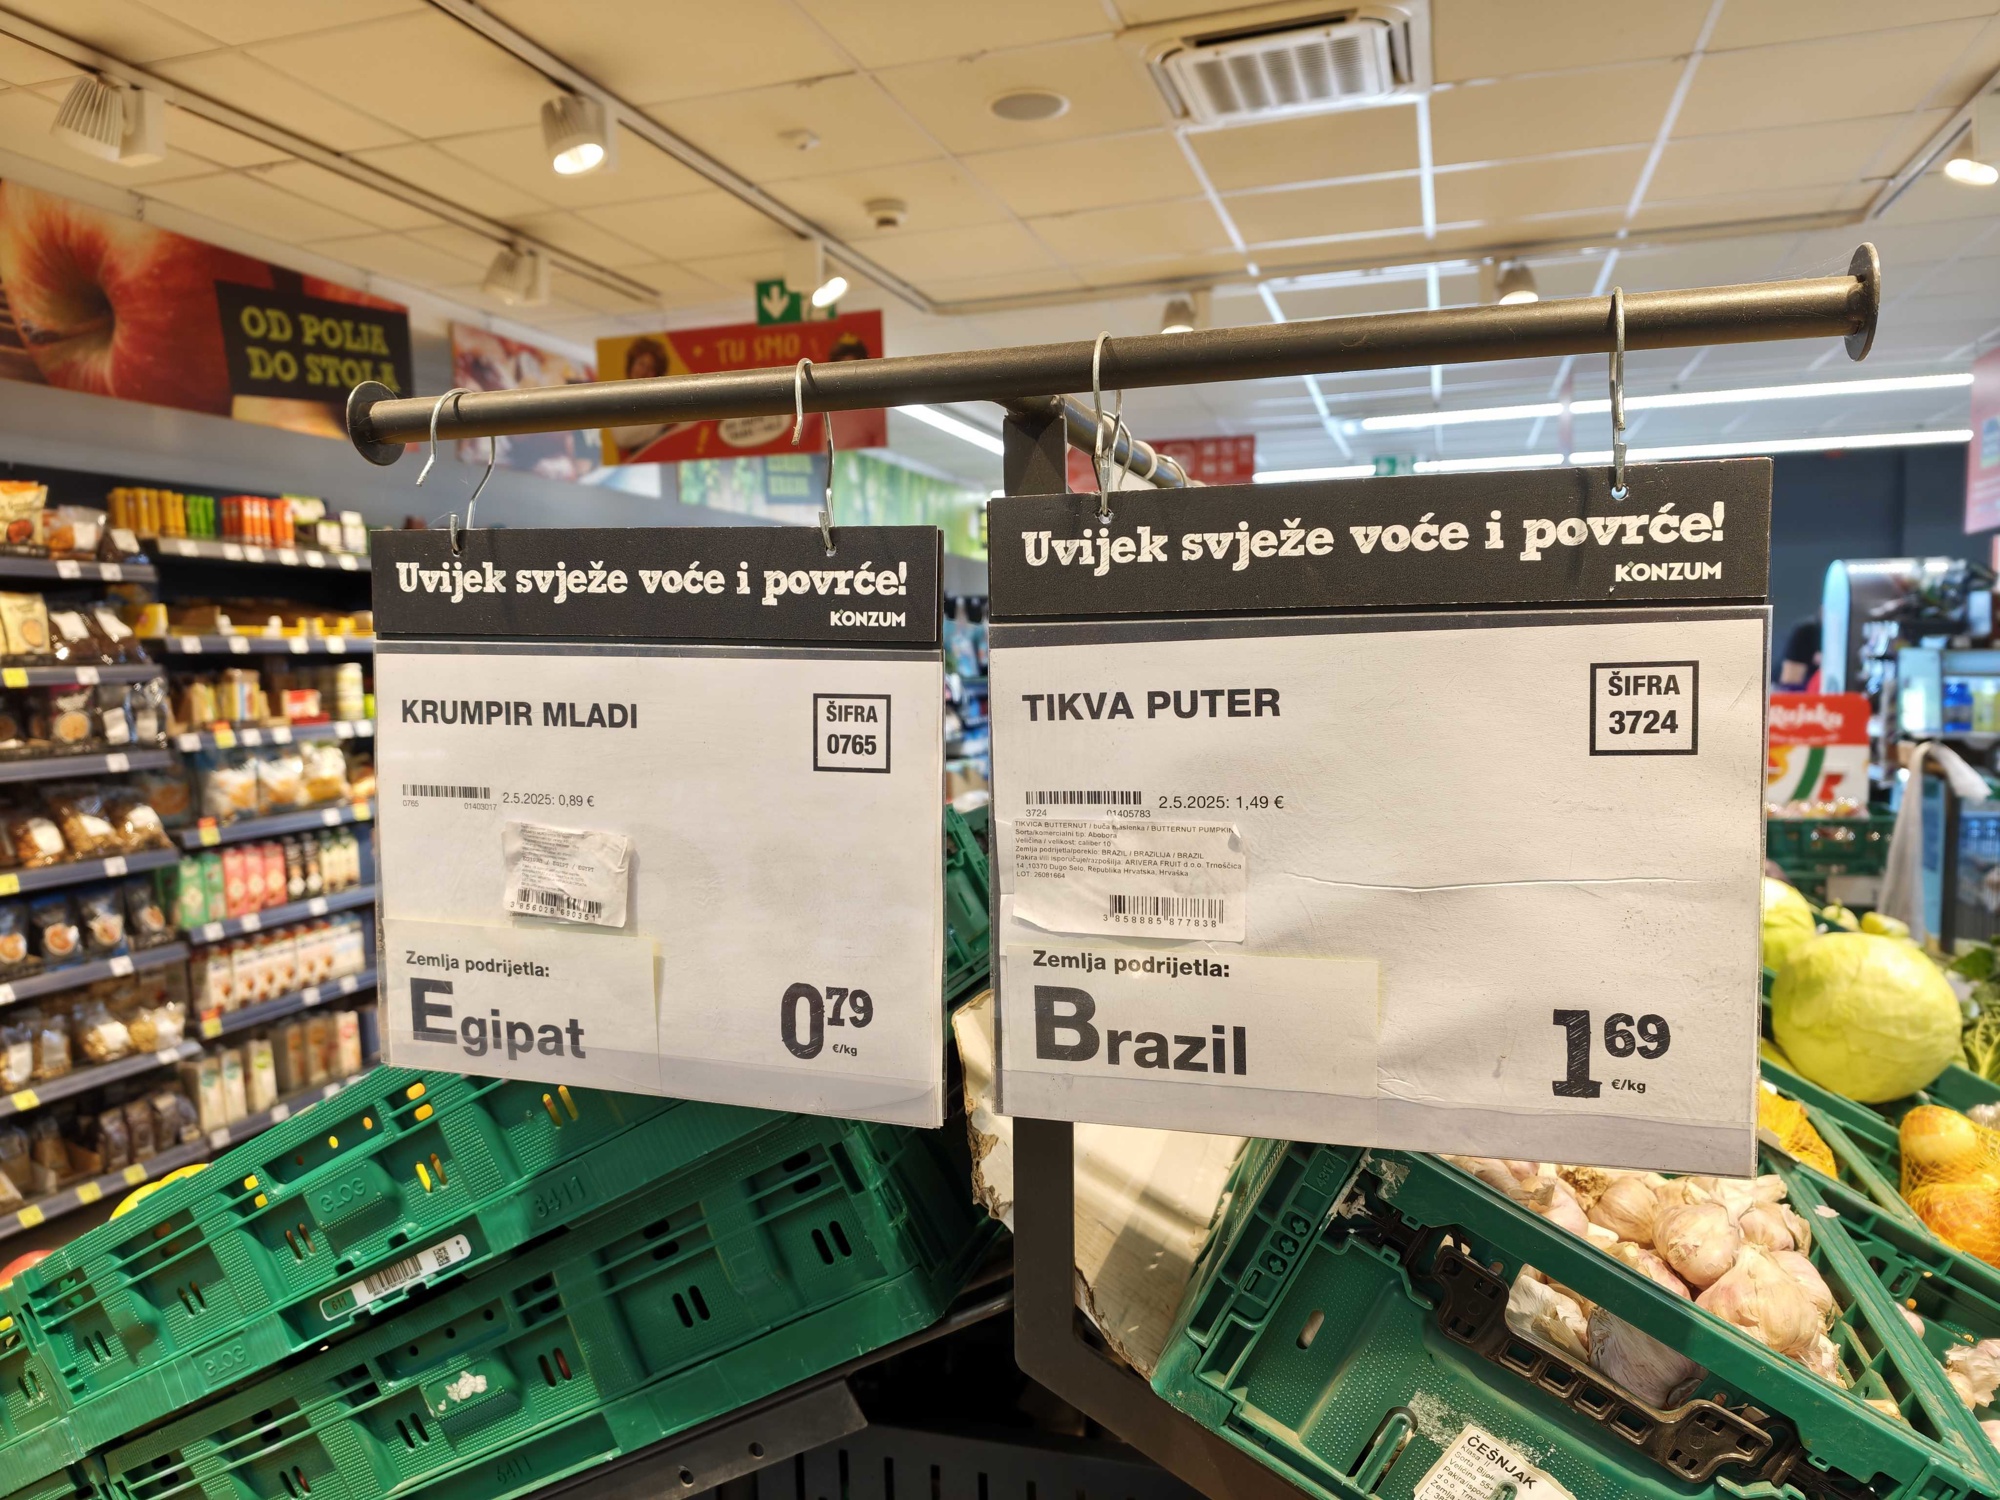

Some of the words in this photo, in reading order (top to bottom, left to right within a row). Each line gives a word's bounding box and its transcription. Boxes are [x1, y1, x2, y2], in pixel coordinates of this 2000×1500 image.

[240, 306, 293, 341] OD
[717, 338, 746, 364] TU
[246, 347, 298, 382] DO
[1021, 526, 1168, 577] Uvijek
[1181, 518, 1334, 572] svježe
[1349, 512, 1470, 555] voće
[1484, 510, 1504, 550] i
[1519, 501, 1724, 561] povrće!
[396, 560, 507, 603] Uvijek
[516, 561, 628, 604] svježe
[638, 560, 725, 596] voće
[737, 560, 750, 595] i
[761, 560, 908, 606] povrće!
[1615, 561, 1722, 582] KONZUM
[830, 609, 906, 628] KONZUM
[1607, 671, 1681, 697] ŠIFRA
[402, 699, 532, 727] KRUMPIR
[543, 701, 638, 729] MLADI
[826, 700, 878, 723] ŠIFRA
[1022, 692, 1134, 722] TIKVA
[1147, 688, 1281, 719] PUTER
[1608, 709, 1679, 735] 3724
[827, 733, 877, 755] 0765
[402, 800, 419, 808] 0765
[464, 802, 497, 811] 01403017
[502, 792, 556, 806] 2.5.2025:
[558, 794, 583, 807] 0,89
[587, 795, 595, 807] €
[1158, 796, 1230, 810] 2.5.2025:
[1236, 796, 1269, 810] 1,49
[1274, 797, 1284, 809] €
[1025, 808, 1047, 817] 3724
[1106, 809, 1151, 818] 01405783
[1044, 821, 1087, 829] BUTTERNUT
[1151, 825, 1196, 833] BUTTERNUT
[1088, 831, 1117, 839] Abobora
[1101, 849, 1128, 857] BRAZIL
[1049, 864, 1068, 872] Dugo
[1087, 866, 1122, 874] Republika
[1159, 869, 1189, 877] Hrvaška
[1205, 862, 1242, 870] Trnoščica
[405, 950, 461, 973] Zemlja
[464, 957, 550, 978] podrijetla:
[1033, 950, 1106, 973] Zemlja
[1114, 956, 1230, 978] podrijetla:
[409, 976, 586, 1061] Egipat
[1034, 984, 1247, 1076] Brazil
[832, 1043, 858, 1057] €/kg
[1611, 1078, 1646, 1094] €/kg
[1467, 1435, 1538, 1490] ČEŠNJAK
